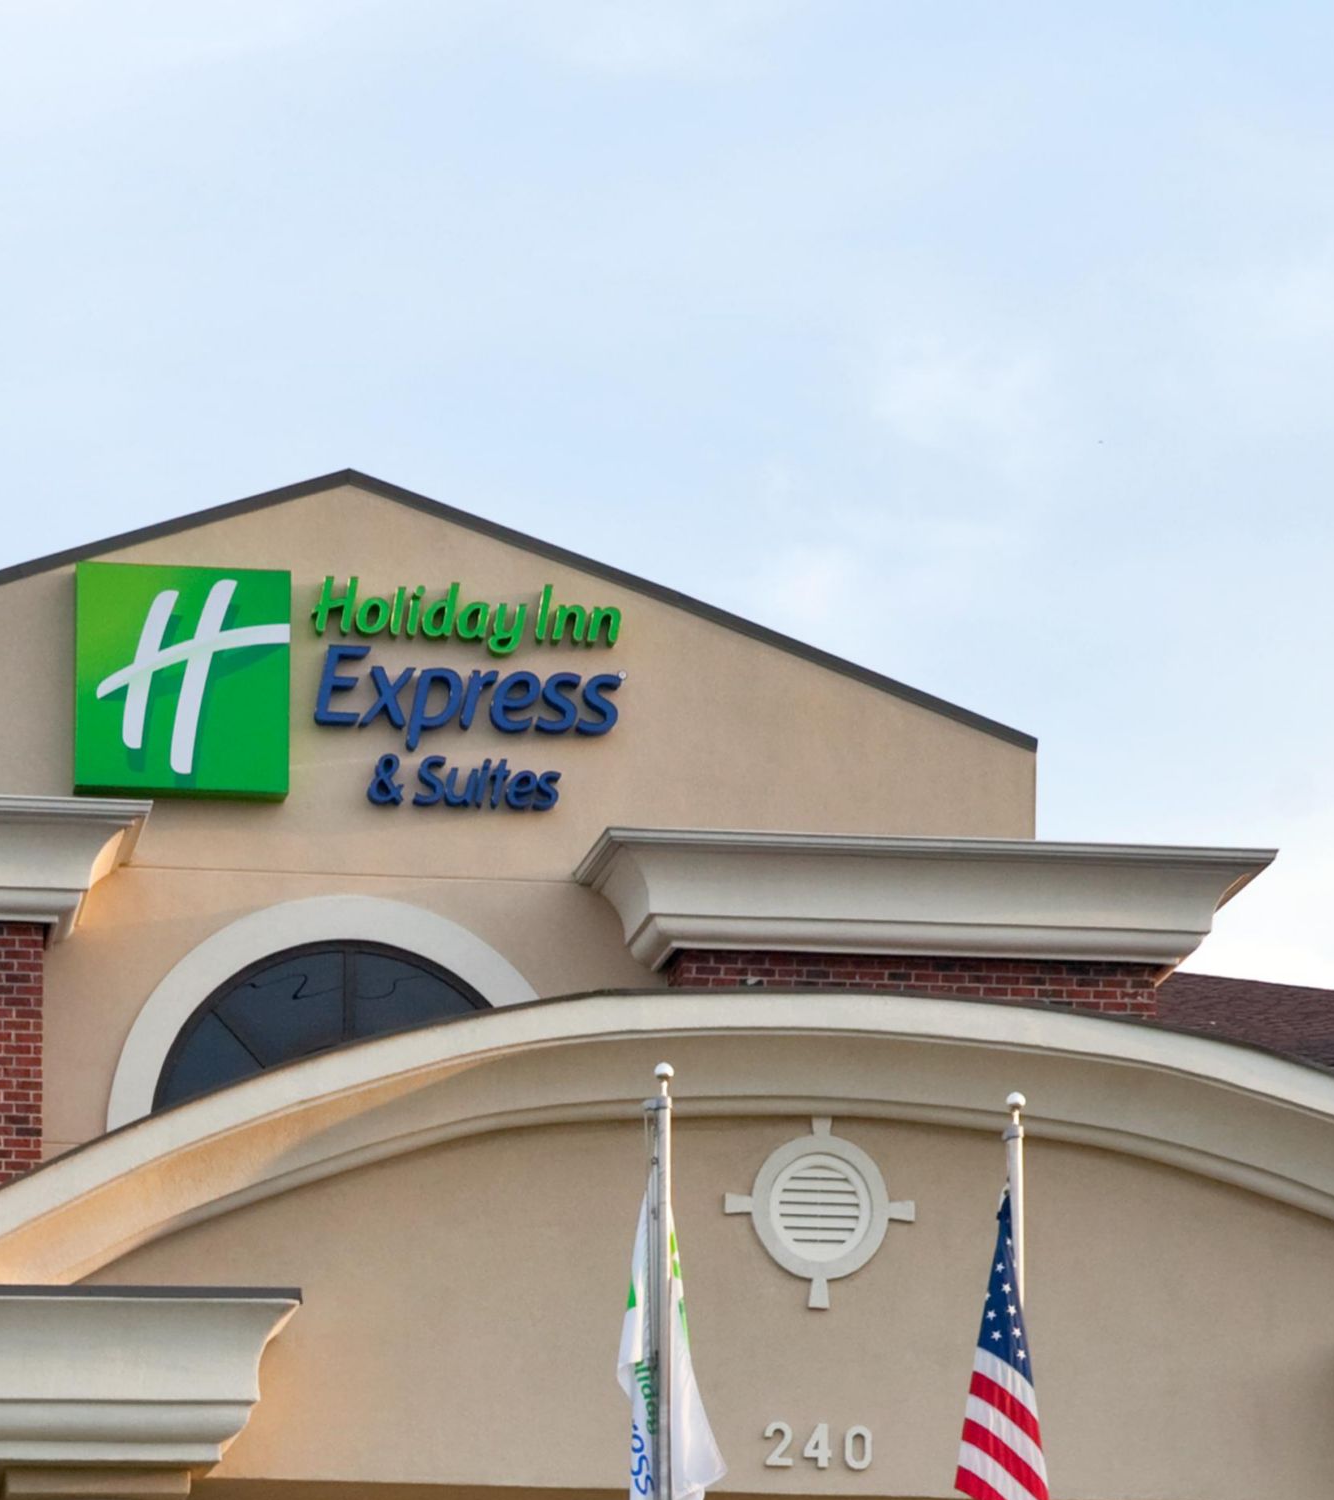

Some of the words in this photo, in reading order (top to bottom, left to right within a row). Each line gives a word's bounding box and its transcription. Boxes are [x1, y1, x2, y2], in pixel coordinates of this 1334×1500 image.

[311, 576, 528, 657] Holiday
[534, 583, 622, 648] Inn
[313, 644, 623, 752] Express
[367, 753, 405, 806] &
[412, 754, 562, 811] Suites
[763, 1420, 873, 1471] 240
